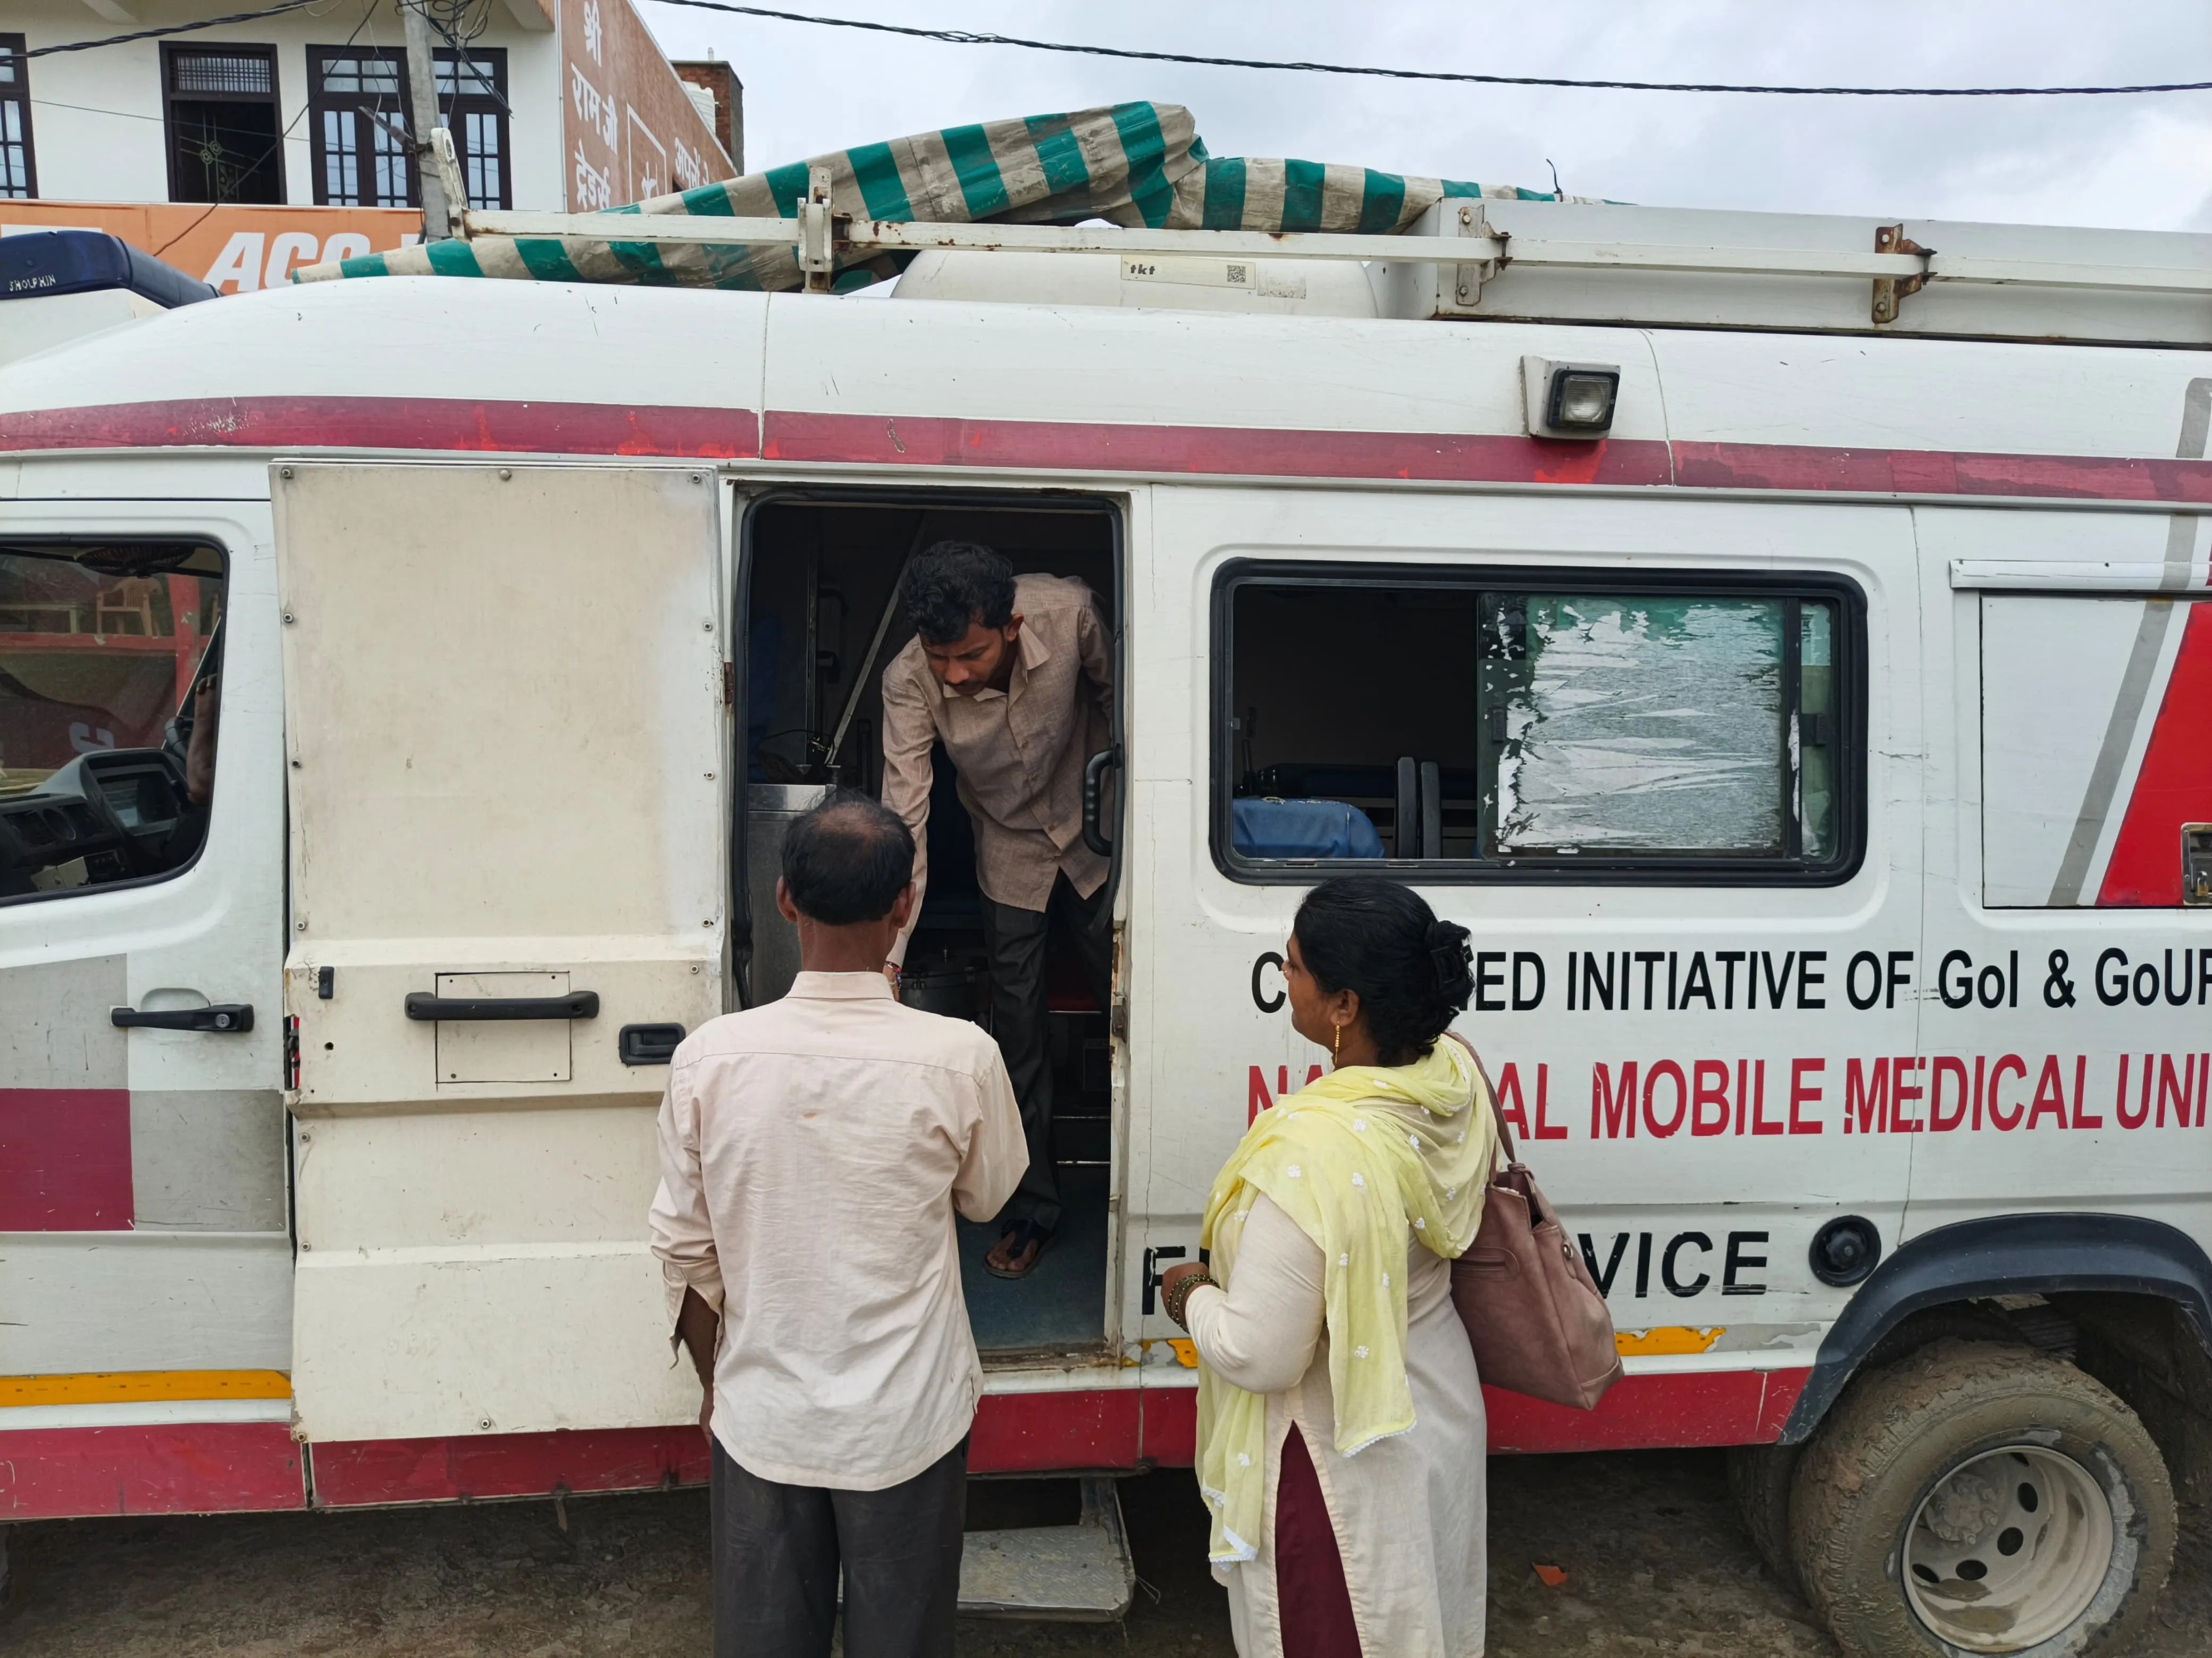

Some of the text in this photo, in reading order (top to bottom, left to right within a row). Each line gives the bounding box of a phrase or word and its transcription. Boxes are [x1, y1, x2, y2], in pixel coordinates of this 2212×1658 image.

[1130, 264, 1155, 275] tkt
[1567, 950, 1827, 1011] INITIATIVE
[1846, 950, 1914, 1010] OF
[2043, 949, 2075, 1008] &
[1590, 1058, 1825, 1140] MOBILE
[1844, 1054, 2103, 1134] MEDICAL
[2116, 1053, 2210, 1131] UNI
[1577, 1231, 1770, 1299] VICE
